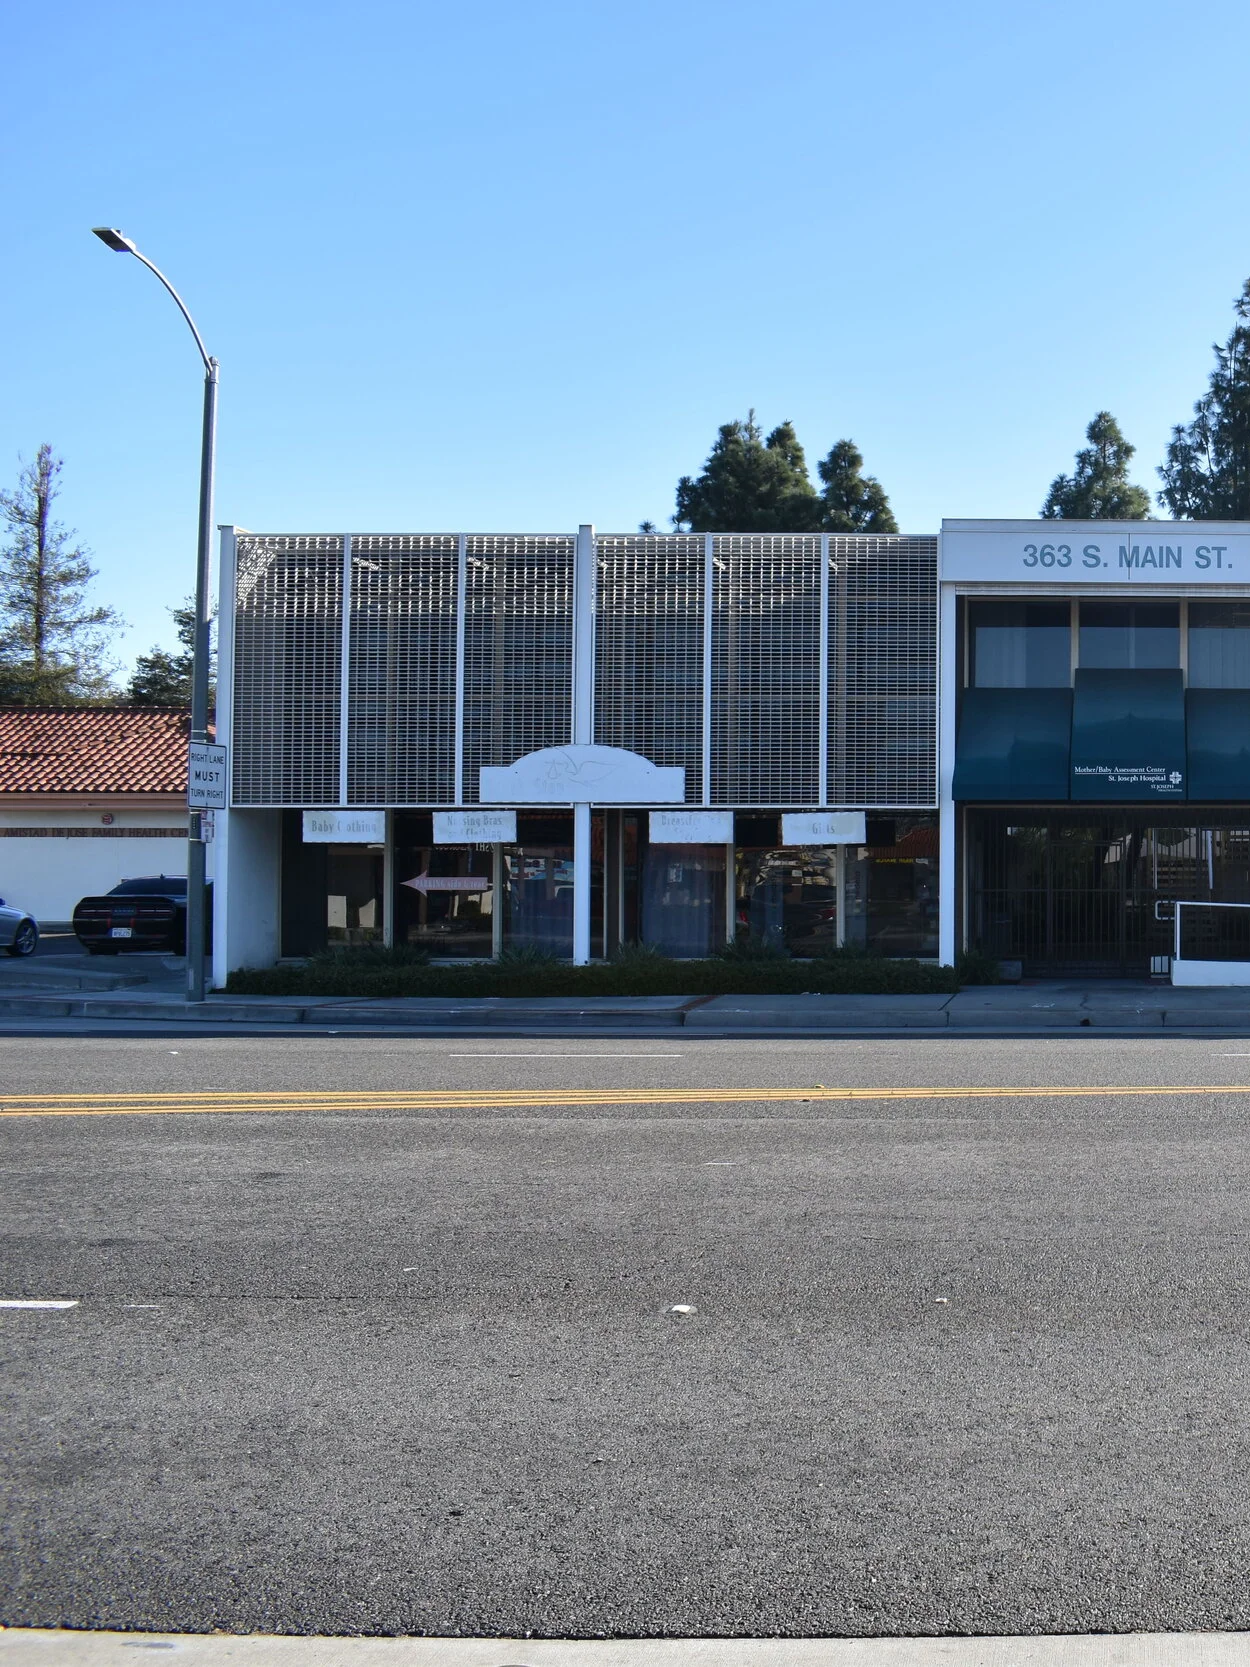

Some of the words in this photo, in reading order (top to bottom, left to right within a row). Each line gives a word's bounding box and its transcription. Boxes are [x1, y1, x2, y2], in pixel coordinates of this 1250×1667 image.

[1023, 544, 1072, 568] 363
[1081, 544, 1108, 568] S.
[1118, 545, 1182, 568] MAIN
[1194, 545, 1233, 569] ST.
[191, 753, 207, 762] RIGHT
[209, 755, 224, 765] LANE
[1074, 765, 1112, 774] Mother/Baby
[195, 770, 220, 782] MUST
[1117, 775, 1138, 783] Joseph
[1140, 775, 1166, 783] Hospital
[191, 788, 205, 797] TURN
[206, 789, 224, 799] RIGHT
[312, 819, 334, 834] Baby
[4, 828, 48, 838] AMISTAD
[92, 828, 126, 838] FAMILY
[128, 828, 166, 838] HEALTH
